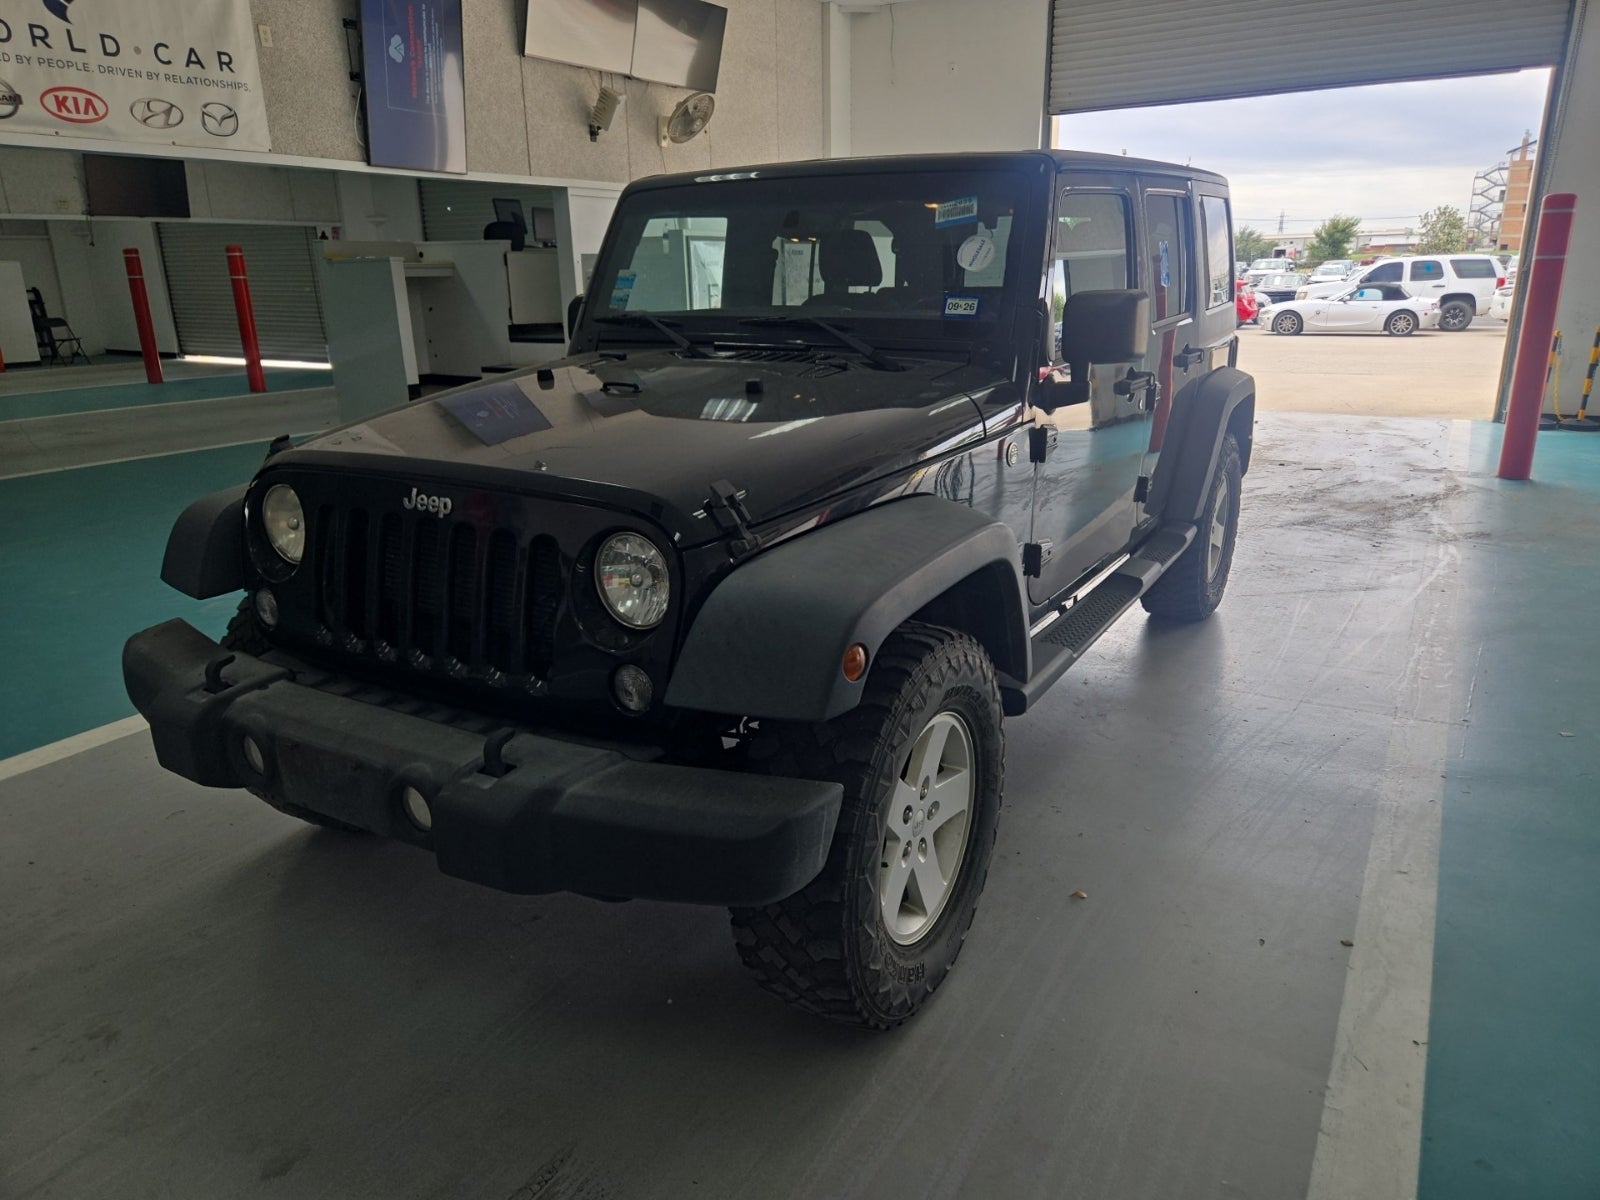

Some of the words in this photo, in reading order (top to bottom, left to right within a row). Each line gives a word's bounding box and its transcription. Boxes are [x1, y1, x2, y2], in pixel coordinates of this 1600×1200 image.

[16, 54, 33, 65] BY
[38, 57, 95, 73] PEOPLE.
[98, 64, 143, 79] DRIVEN
[146, 71, 161, 81] BY
[153, 42, 236, 74] CAR
[53, 94, 101, 117] KIA
[402, 487, 453, 519] Jeep
